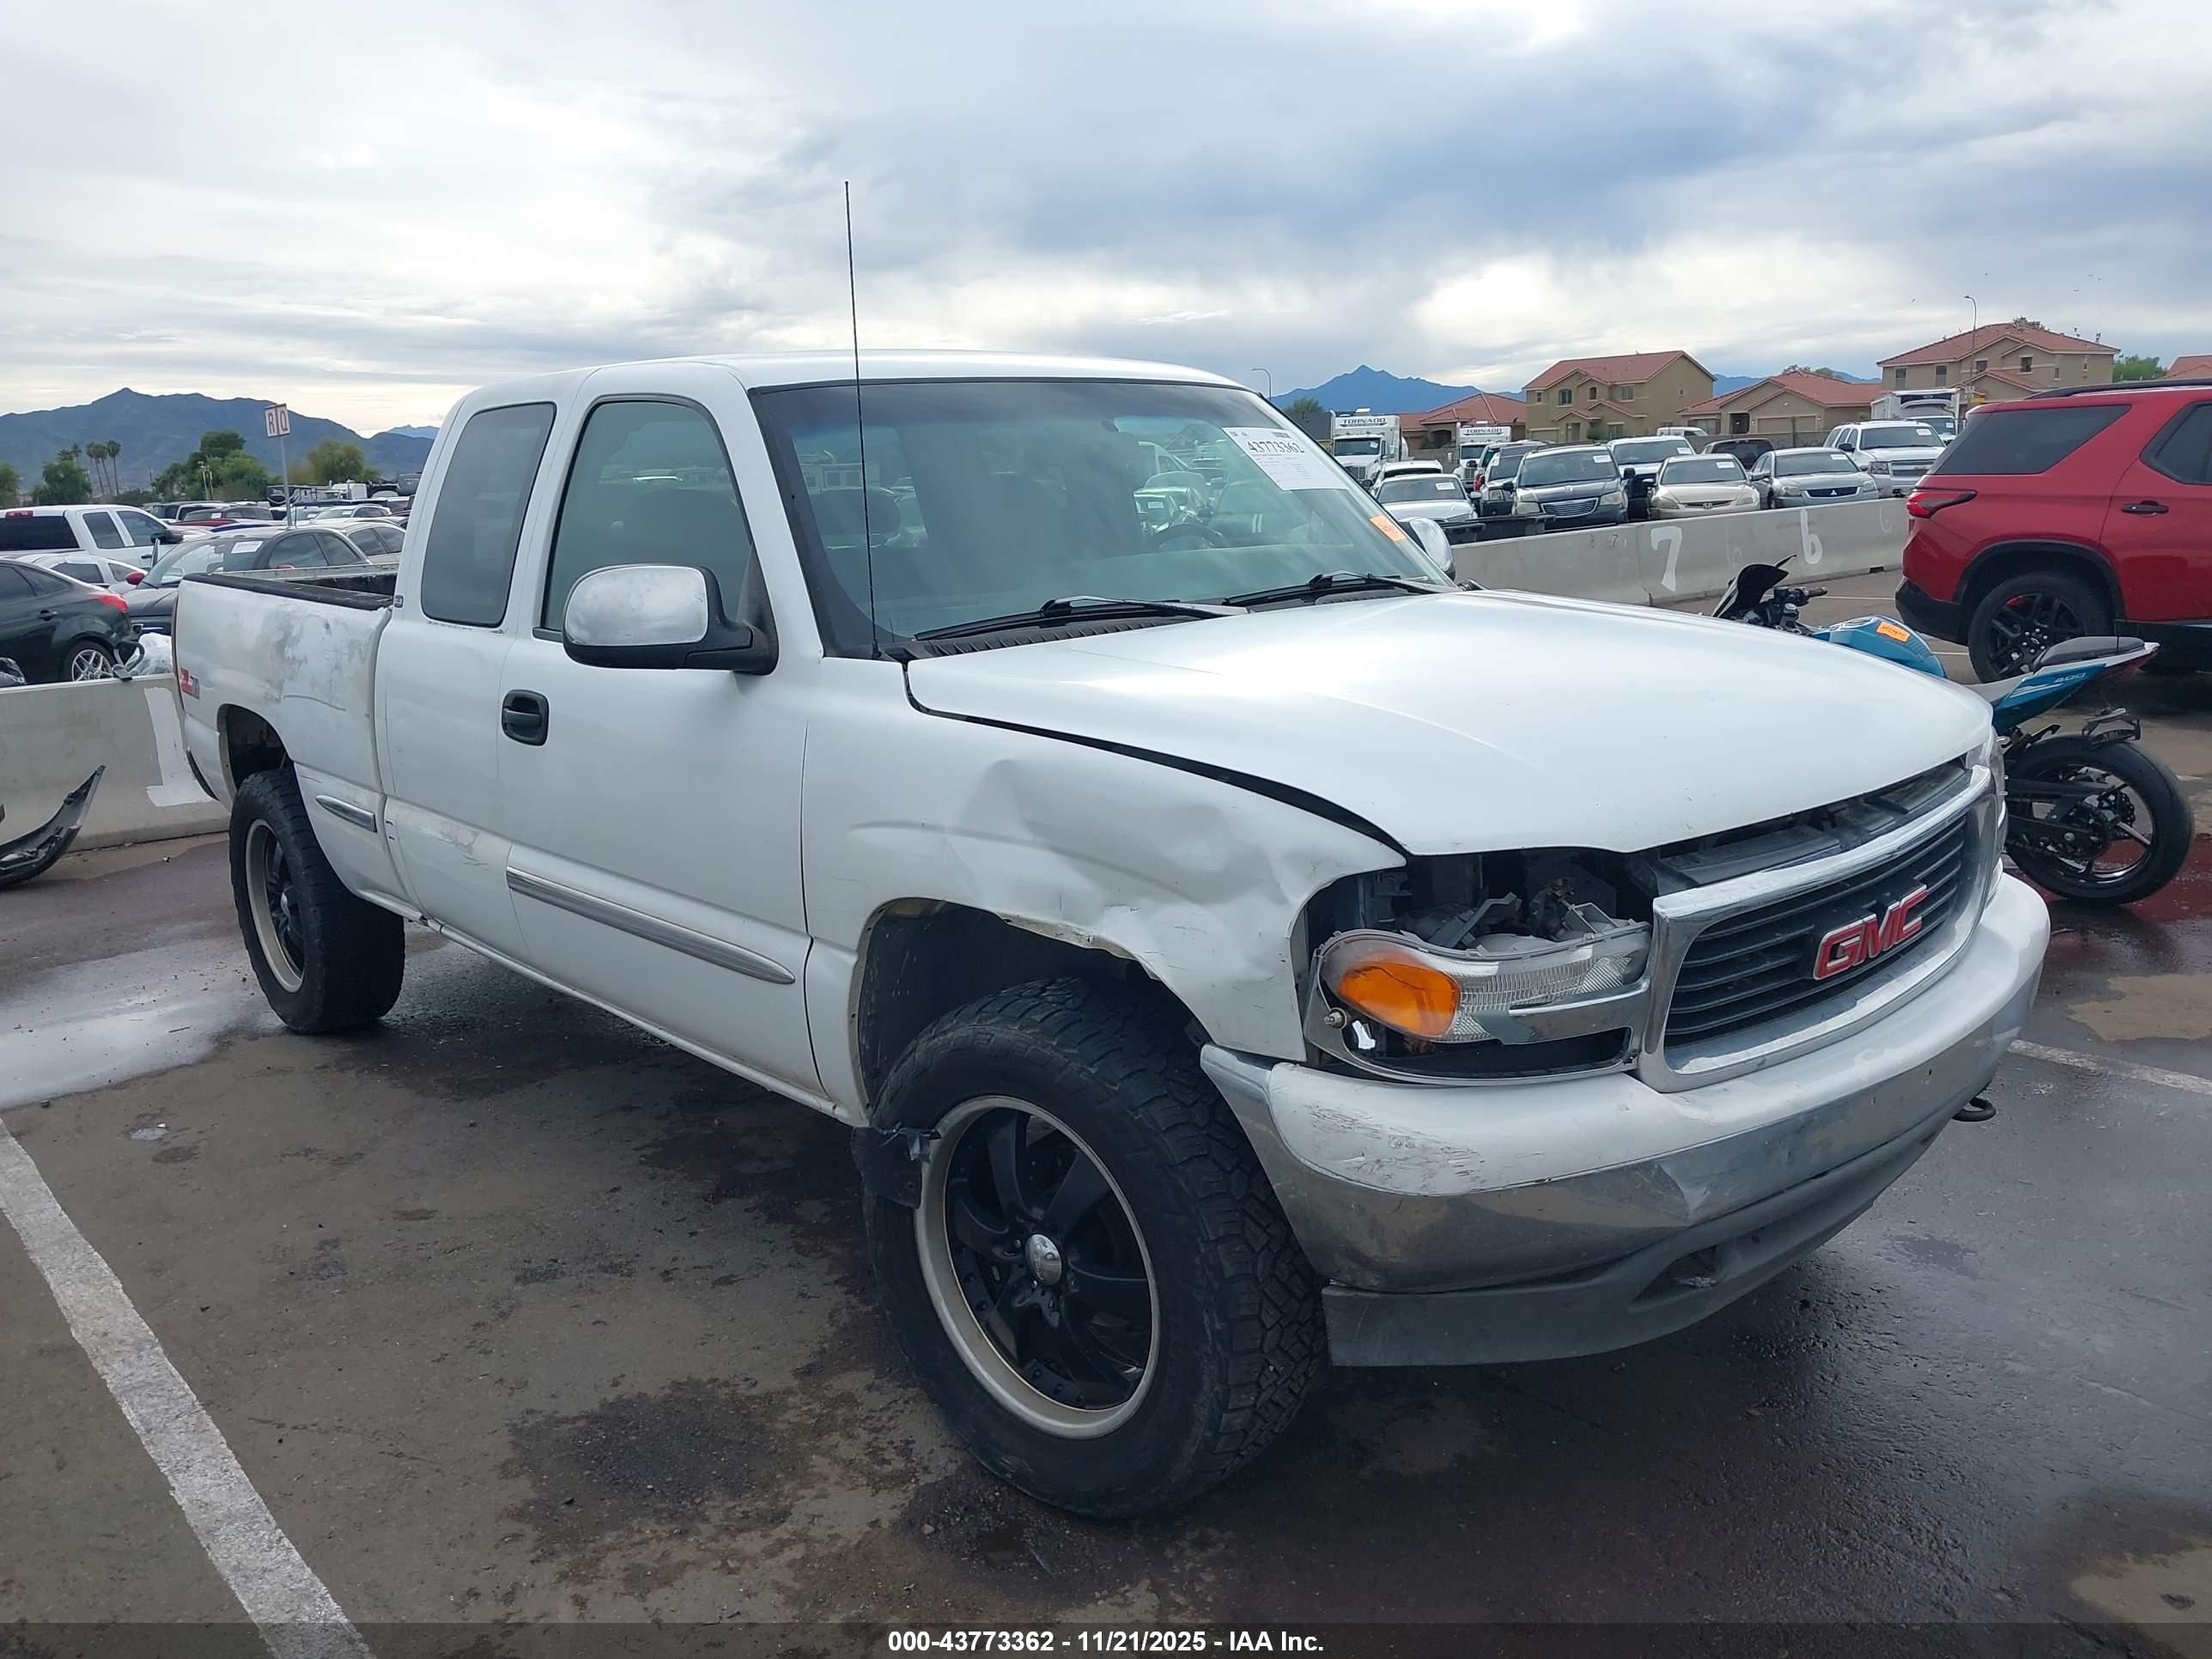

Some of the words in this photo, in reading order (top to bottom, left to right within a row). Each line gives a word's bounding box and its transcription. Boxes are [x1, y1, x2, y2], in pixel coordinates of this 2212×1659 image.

[1248, 441, 1305, 453] 43773362
[1650, 526, 1682, 592] 7
[1814, 884, 1929, 981] GMC
